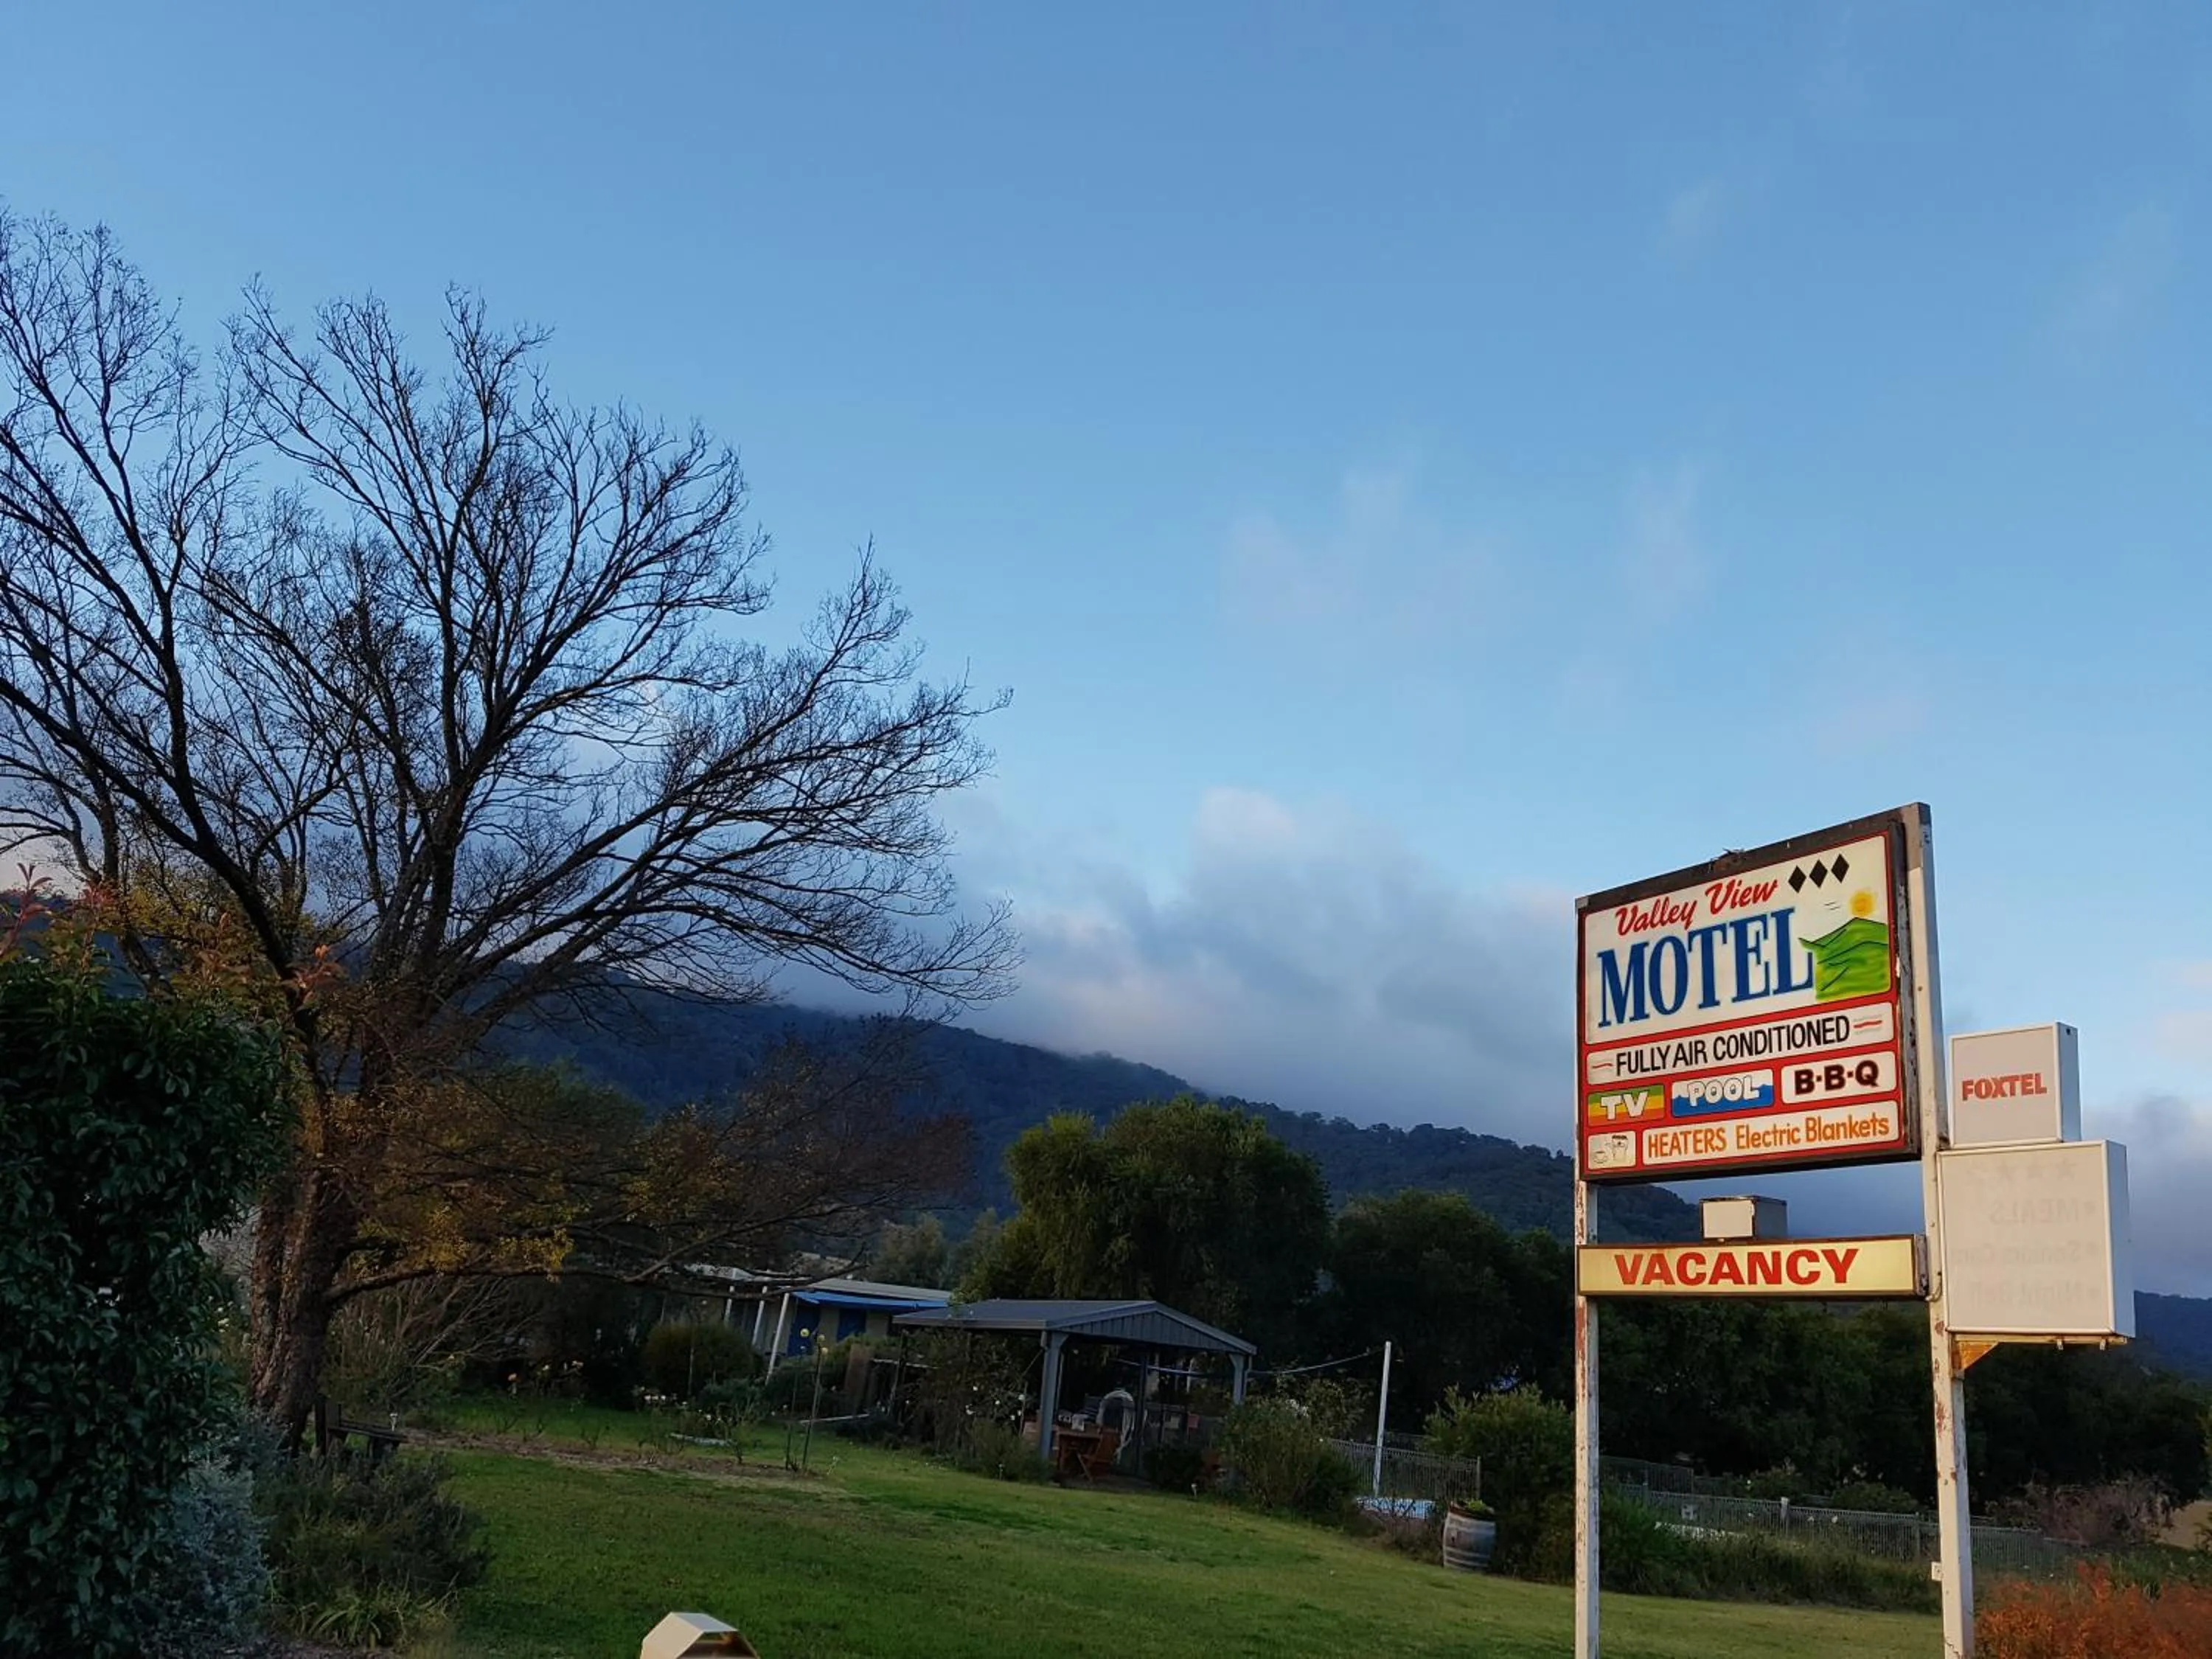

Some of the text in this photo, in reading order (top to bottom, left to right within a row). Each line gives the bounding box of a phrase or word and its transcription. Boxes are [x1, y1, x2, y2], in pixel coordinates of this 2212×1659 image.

[1615, 877, 1778, 936] Valley View
[1597, 907, 1813, 1028] MOTEL
[1615, 1015, 1850, 1077] FULLY AIR CONDITIONED
[1600, 1091, 1649, 1121] TV
[1686, 1075, 1760, 1107] POOL
[1961, 1073, 2047, 1102] FOXTEL
[1648, 1112, 1889, 1158] HEATERS Electric Blankets
[1614, 1248, 1860, 1286] VACANCY
